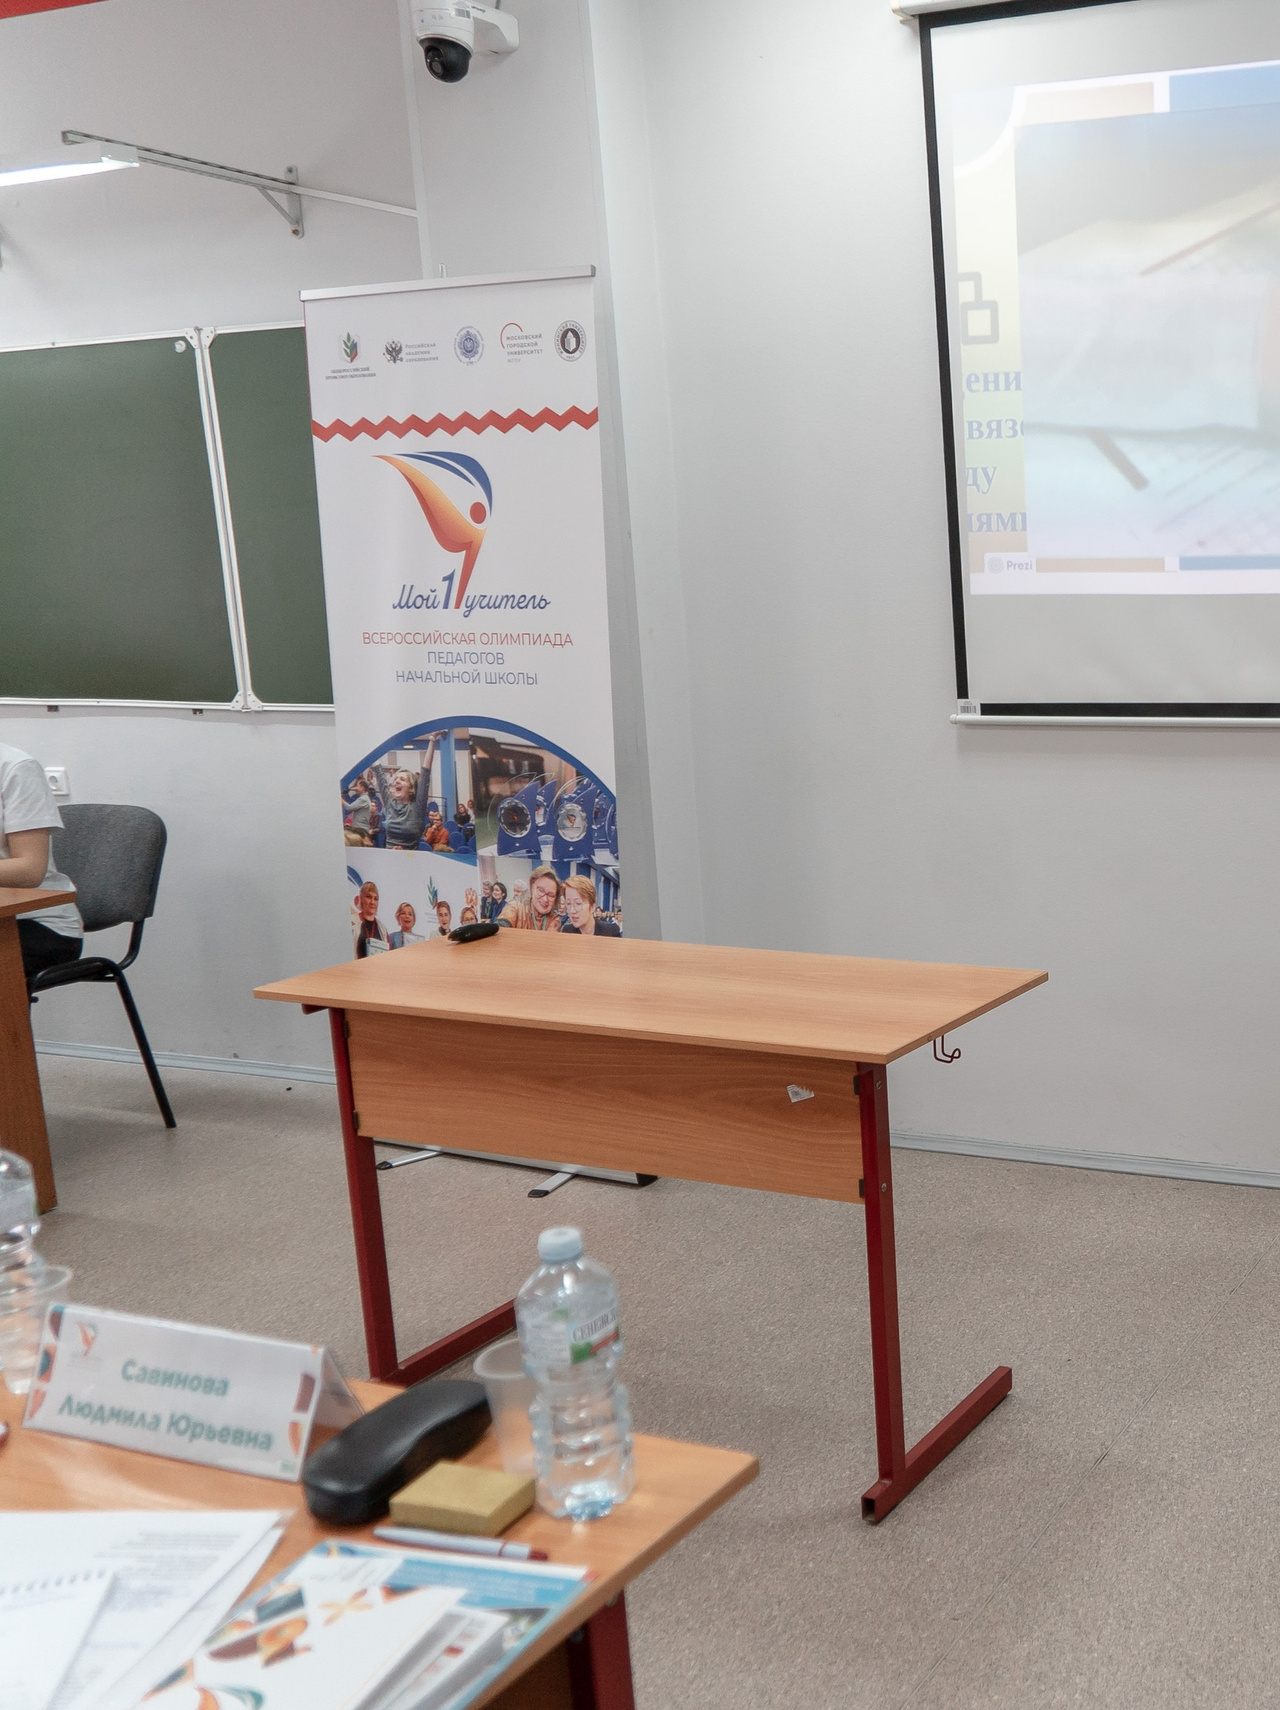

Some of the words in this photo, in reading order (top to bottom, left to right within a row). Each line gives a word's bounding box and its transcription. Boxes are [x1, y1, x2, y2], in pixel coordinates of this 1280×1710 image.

[507, 341, 538, 349] ГОРОДСКОЙ
[966, 370, 1022, 393] ени
[1006, 560, 1033, 571] Prezi
[392, 584, 441, 610] Мой
[462, 593, 551, 618] учитель
[362, 630, 476, 645] ВСЕРОССИЙСКАЯ
[480, 632, 574, 648] ОЛИМПИАДА
[427, 651, 505, 666] ПЕДАГОГОВ
[396, 669, 481, 684] НАЧАЛЬНОЙ
[484, 672, 538, 685] ШКОЛЫ
[120, 1358, 230, 1397] Савинова
[58, 1394, 162, 1432] Людмила
[166, 1412, 275, 1452] Юрьевна
